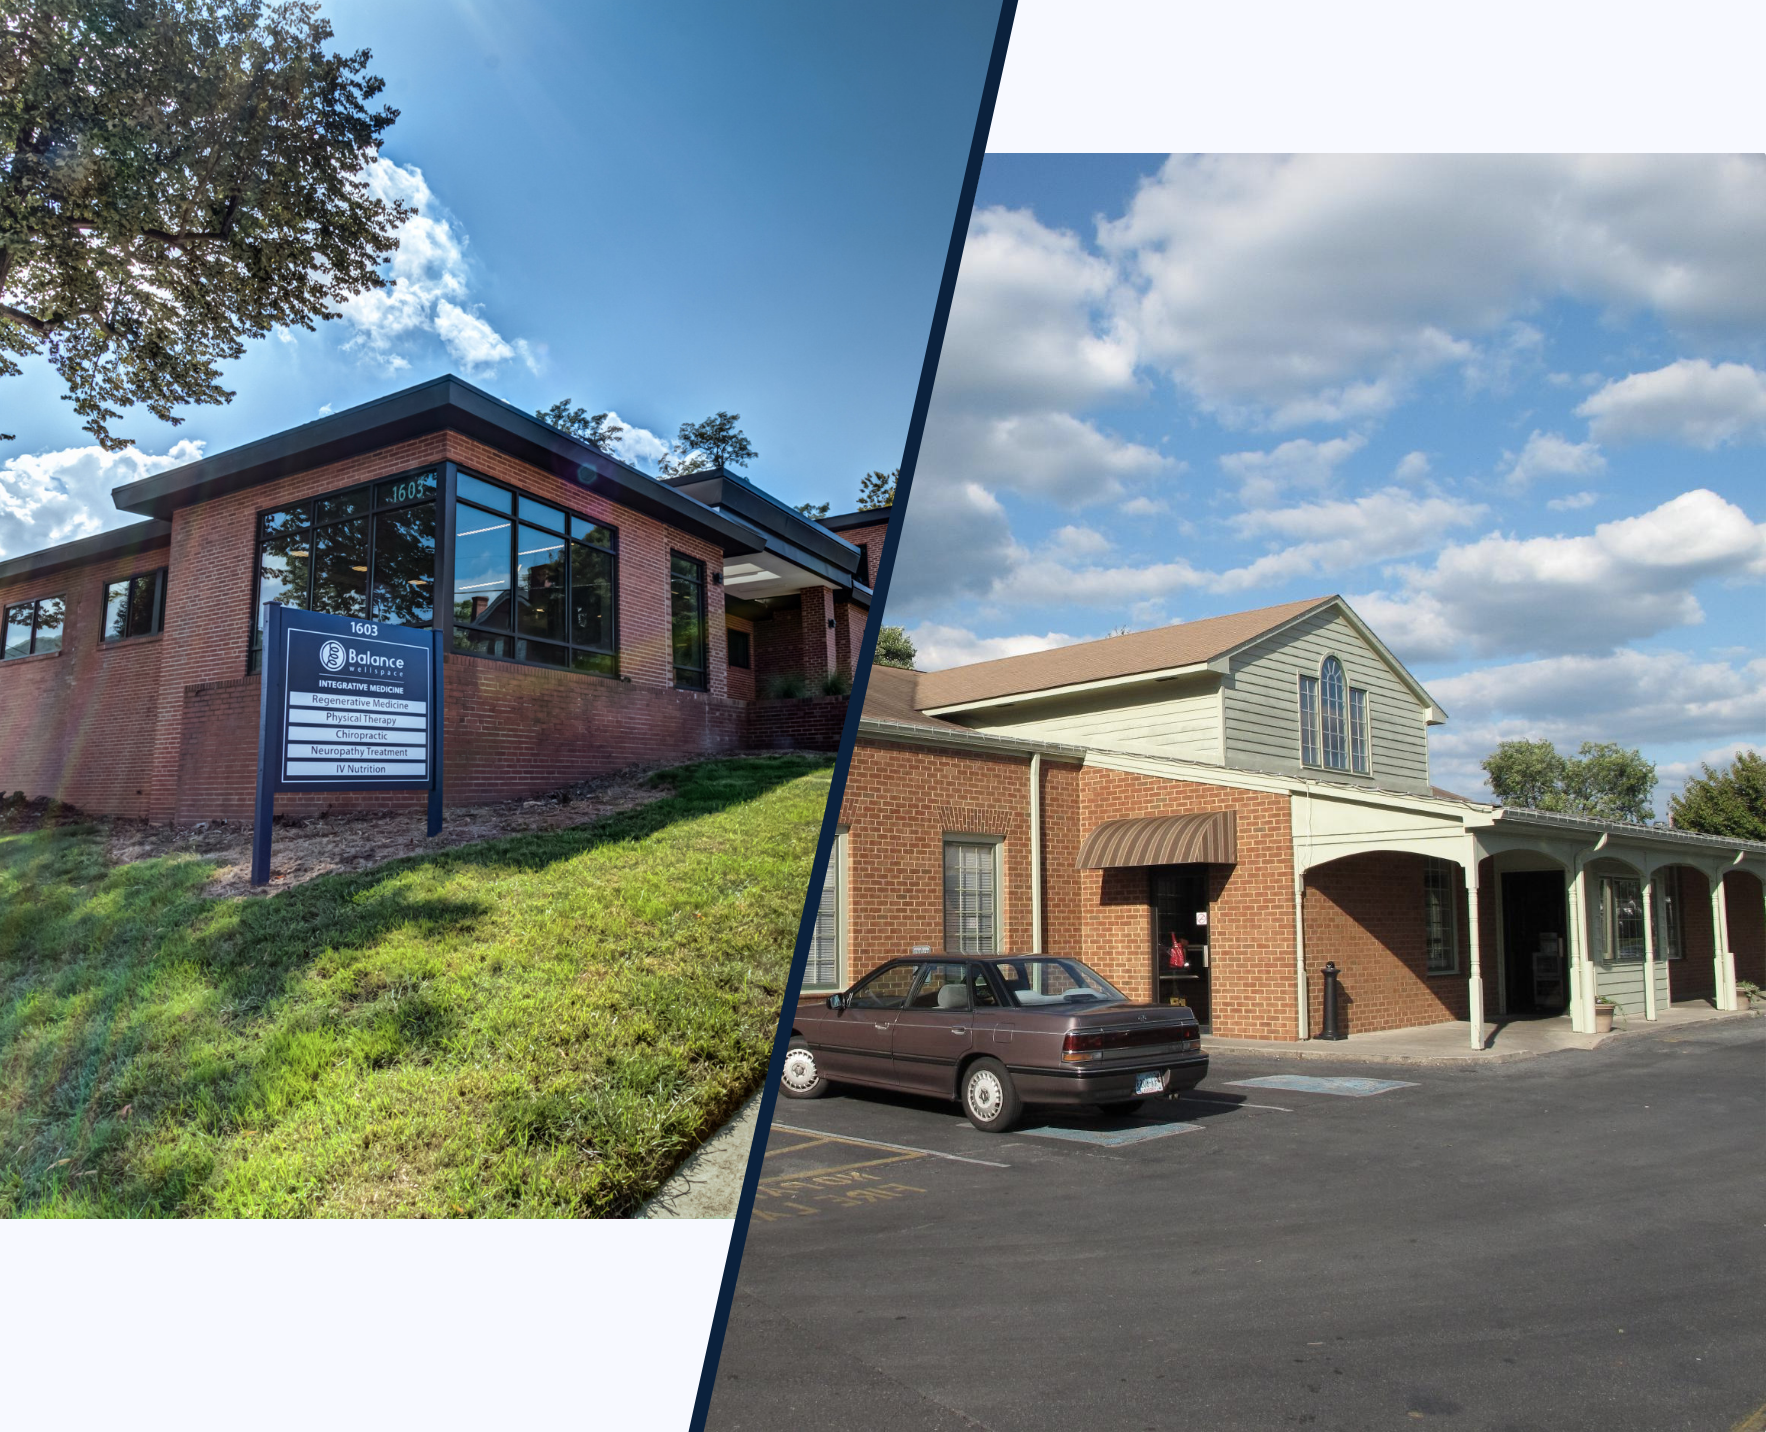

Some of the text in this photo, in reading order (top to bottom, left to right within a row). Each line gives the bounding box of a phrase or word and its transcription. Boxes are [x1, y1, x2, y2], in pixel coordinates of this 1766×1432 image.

[392, 479, 424, 502] 1603
[350, 621, 378, 636] 1603
[348, 648, 404, 669] Balance
[349, 666, 404, 677] wellspace
[318, 679, 404, 694] INTEGRATIVE MEDICINE
[312, 694, 409, 710] Regenerative Medicine
[326, 711, 397, 726] Physical Therapy
[335, 729, 388, 741] Chiropractic
[311, 745, 408, 757] Neuropathy Treatment
[336, 764, 386, 773] IV Nutrition
